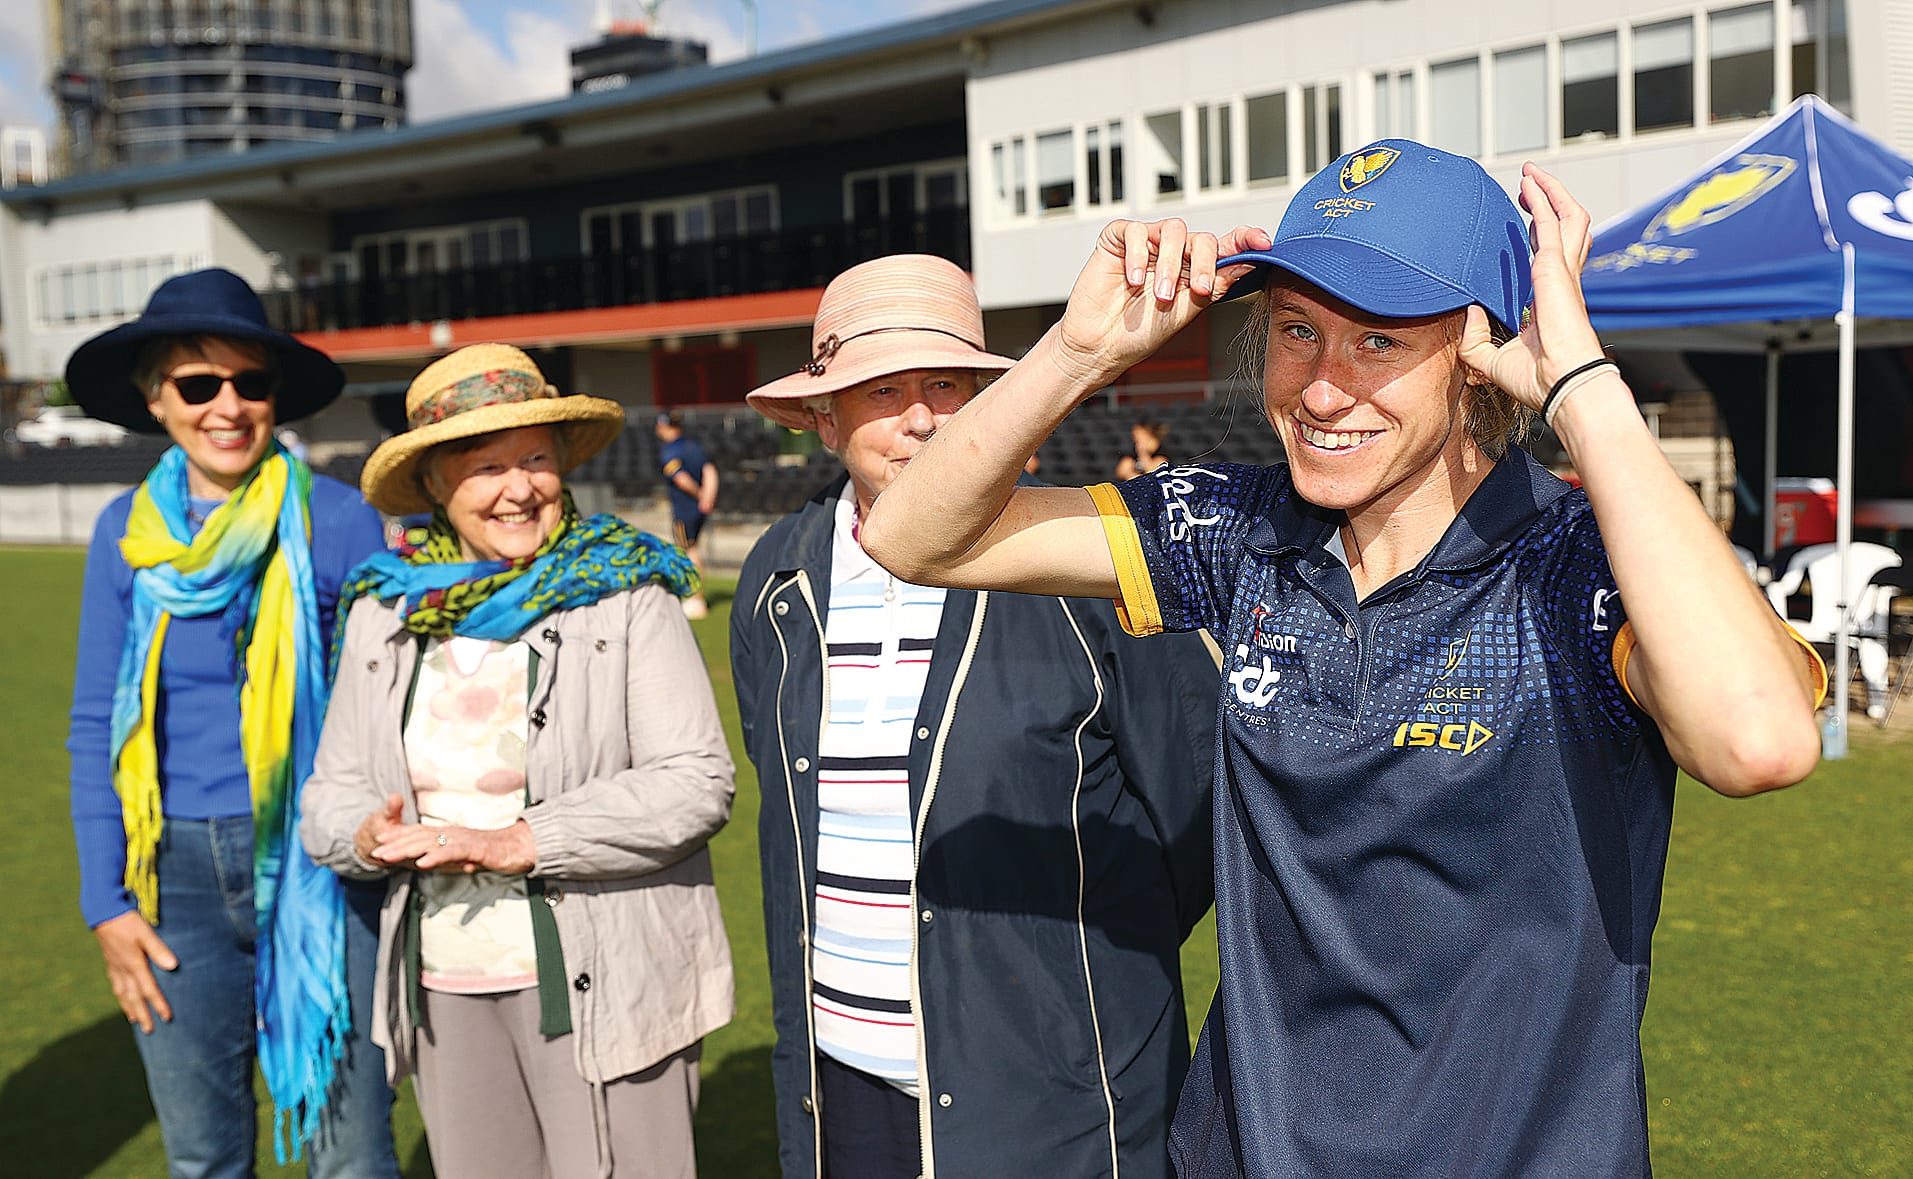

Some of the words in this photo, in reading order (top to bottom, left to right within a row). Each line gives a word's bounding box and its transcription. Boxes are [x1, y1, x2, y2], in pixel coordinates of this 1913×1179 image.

[1313, 198, 1377, 211] CRICKET
[1322, 208, 1355, 218] ACT
[1424, 687, 1485, 700] ICKET
[1224, 698, 1267, 726] CENTRES
[1422, 702, 1462, 715] ACT
